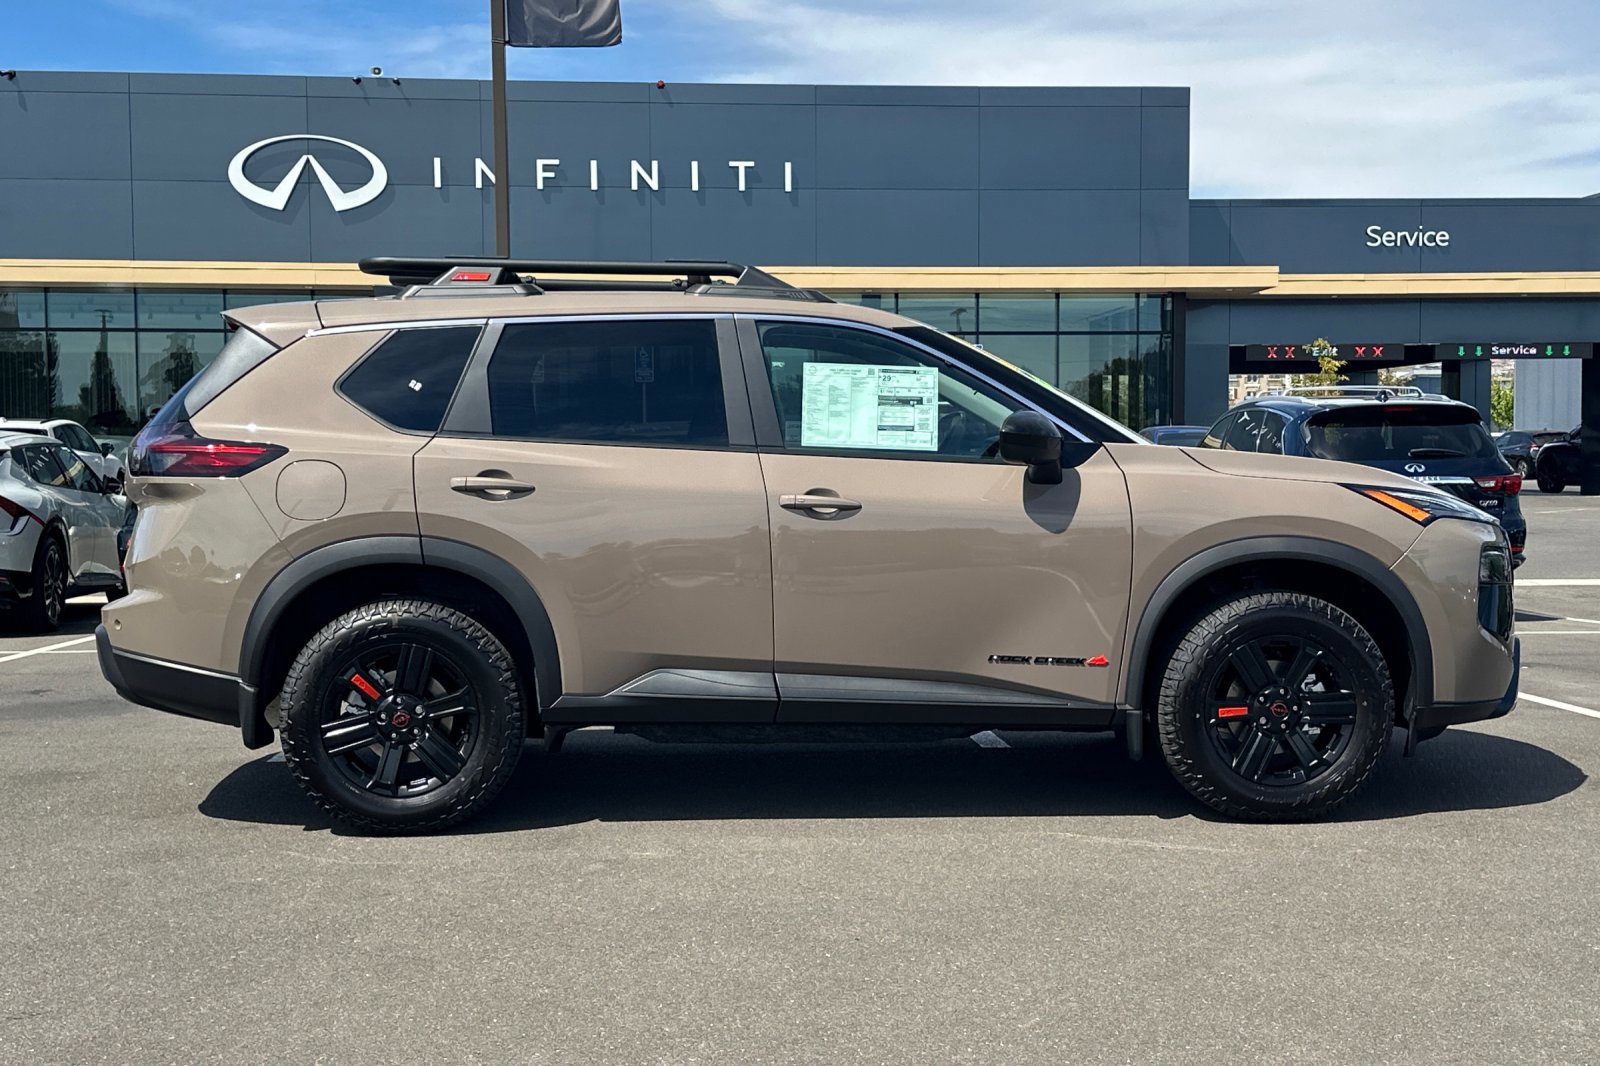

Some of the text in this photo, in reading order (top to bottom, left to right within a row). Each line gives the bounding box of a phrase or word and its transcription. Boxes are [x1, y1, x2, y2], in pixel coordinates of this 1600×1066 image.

[433, 157, 792, 192] INFINITI
[1366, 225, 1450, 247] Service
[1491, 345, 1537, 355] Service
[988, 654, 1087, 667] ROCK CREEK
